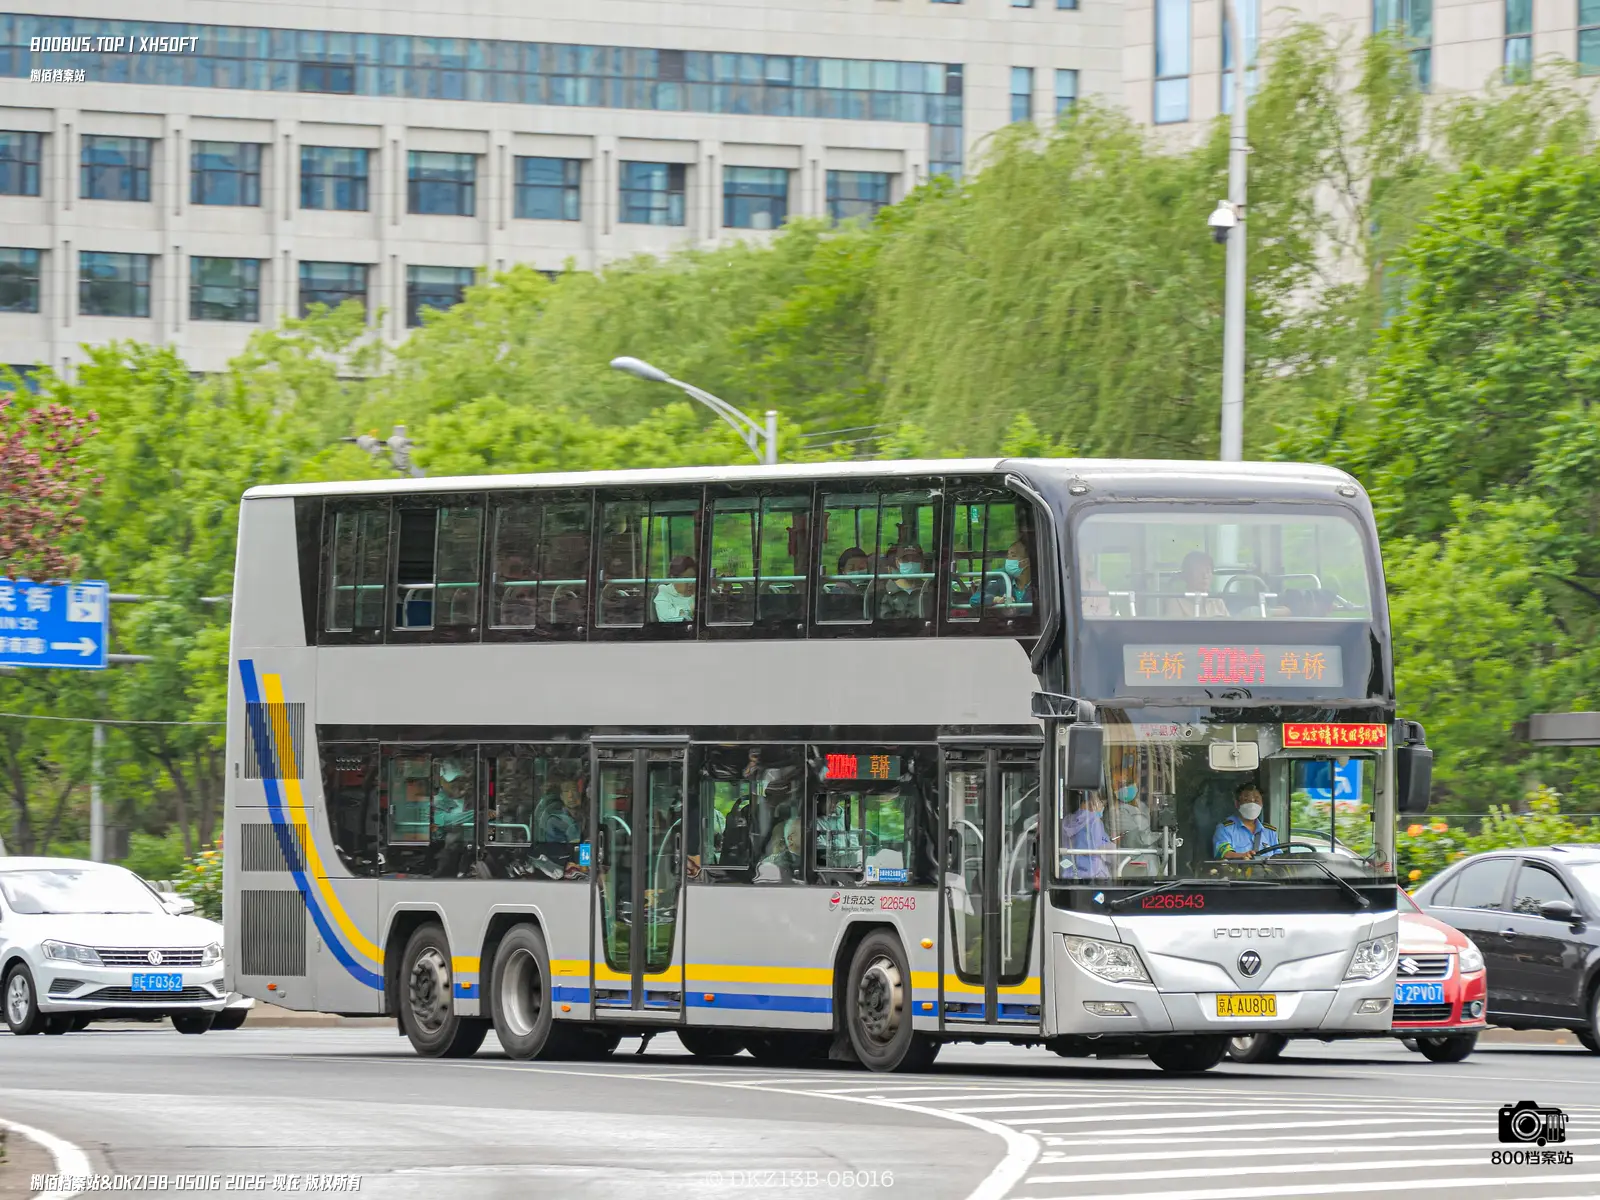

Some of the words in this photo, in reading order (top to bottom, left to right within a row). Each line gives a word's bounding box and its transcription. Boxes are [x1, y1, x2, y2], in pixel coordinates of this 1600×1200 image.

[1136, 651, 1187, 680] 草桥
[1278, 651, 1327, 681] 草桥
[869, 754, 891, 779] 草桥
[843, 894, 876, 906] 北京公交
[879, 896, 916, 911] 1226543
[1141, 894, 1205, 909] 1226543
